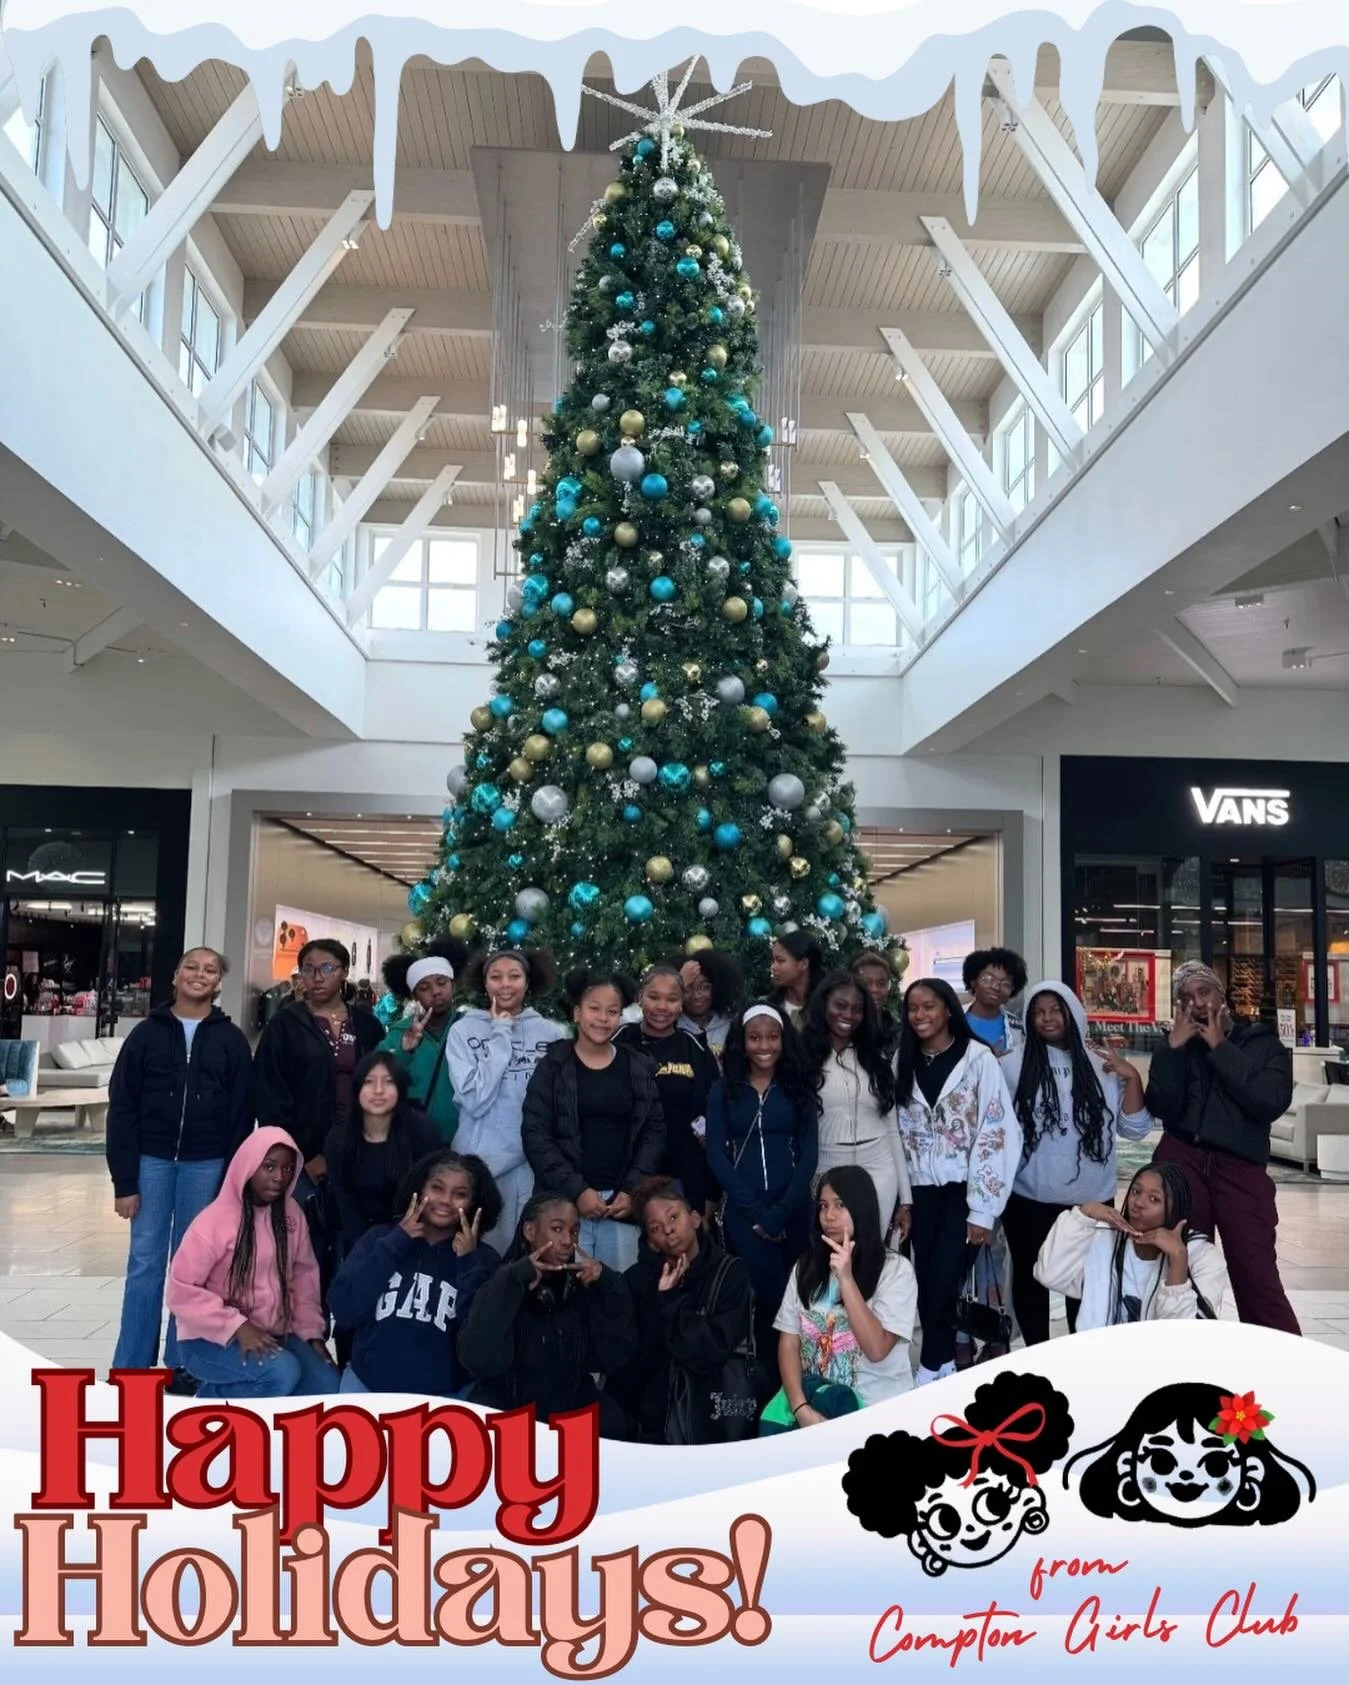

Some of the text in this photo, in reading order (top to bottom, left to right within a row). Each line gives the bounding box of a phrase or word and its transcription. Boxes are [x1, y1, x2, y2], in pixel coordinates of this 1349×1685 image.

[1191, 786, 1291, 827] VANS
[1096, 1021, 1124, 1033] Meet
[1128, 1021, 1150, 1033] The
[375, 1271, 458, 1332] GAP
